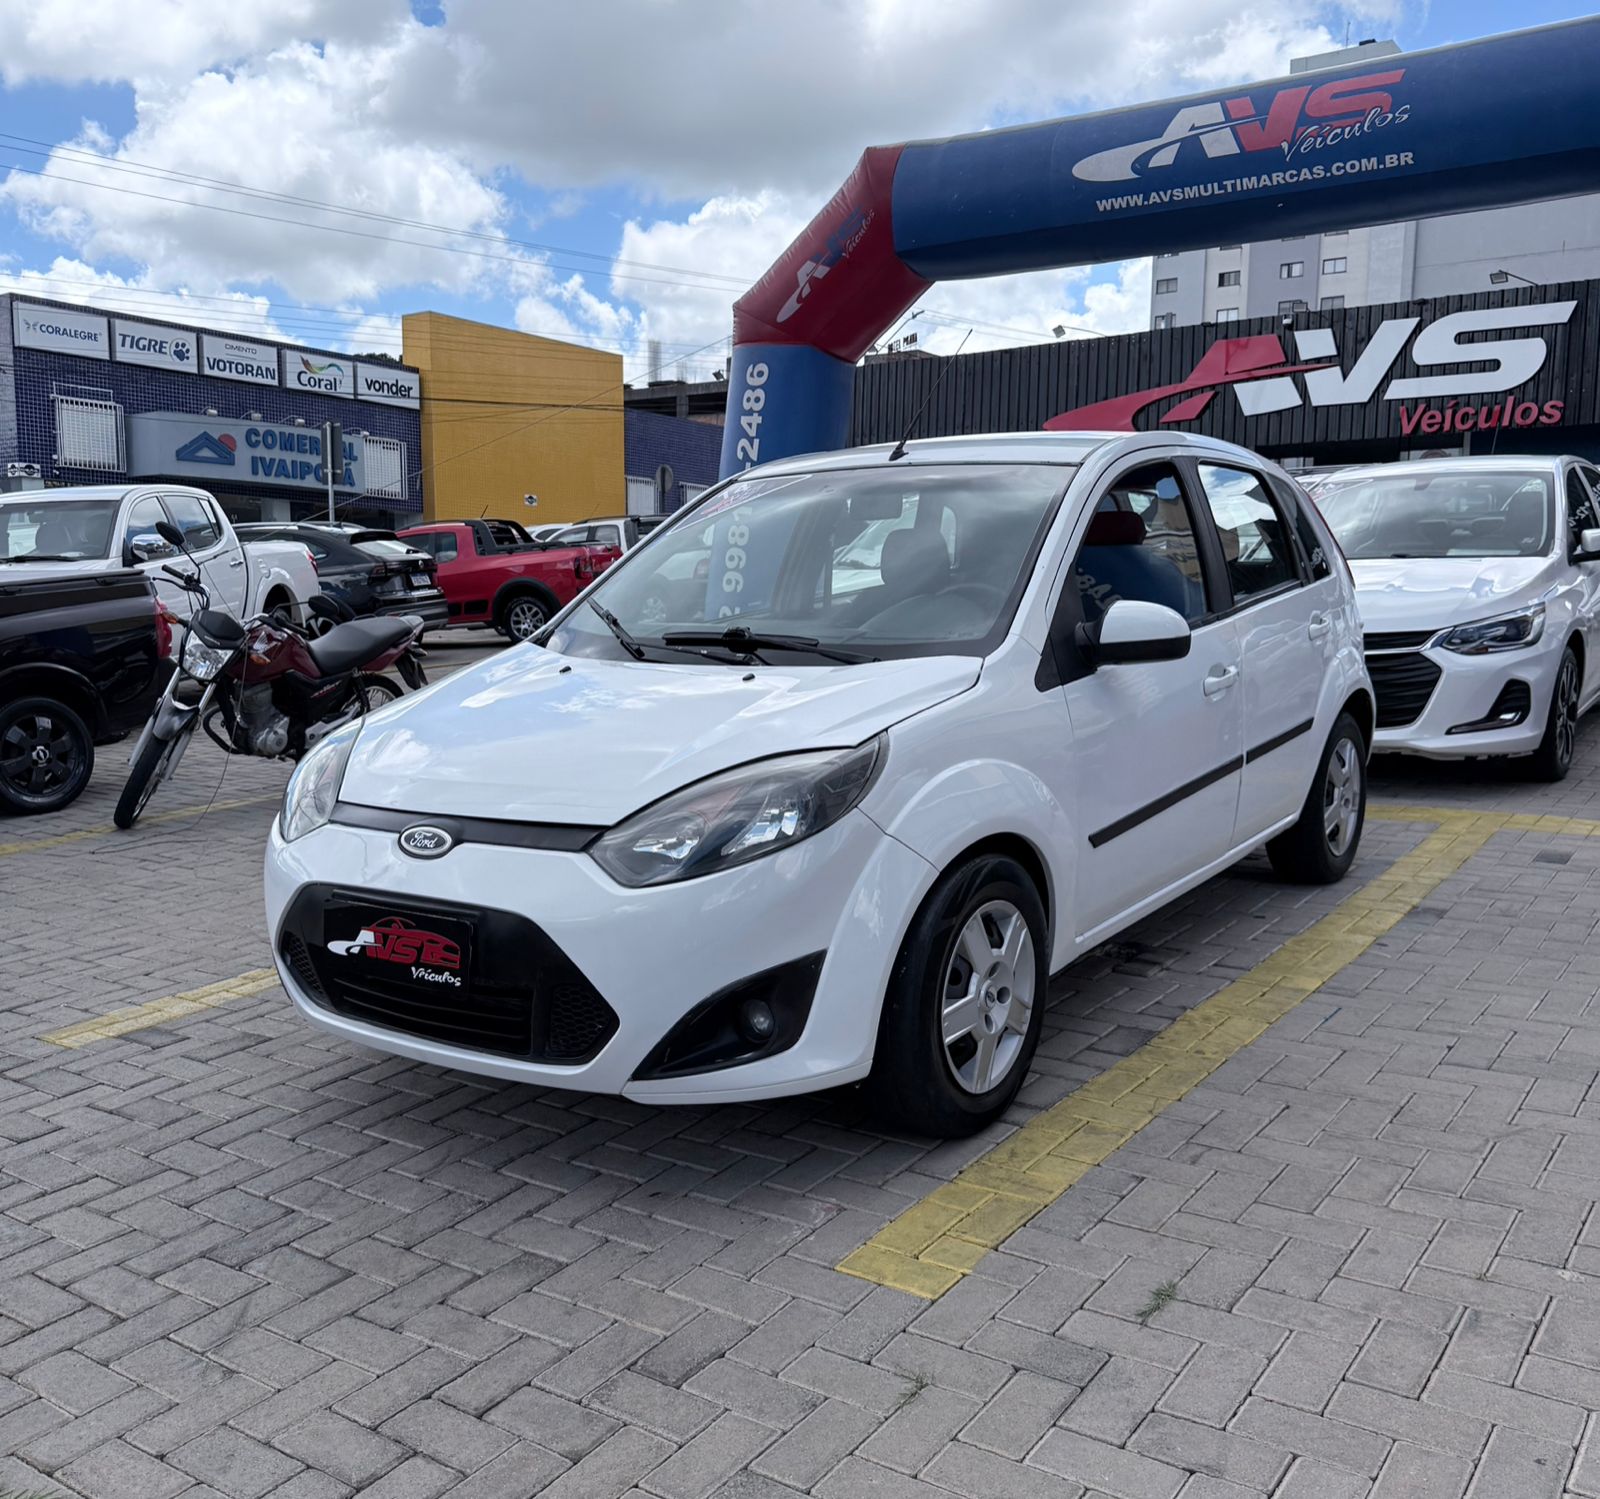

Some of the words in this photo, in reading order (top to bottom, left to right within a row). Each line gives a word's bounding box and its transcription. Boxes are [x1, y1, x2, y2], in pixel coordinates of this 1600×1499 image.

[1072, 68, 1406, 182] AVS
[1281, 102, 1411, 162] Veículos
[1096, 151, 1415, 212] WWW.AVSMULTIMARCAS.COM.BR
[39, 323, 99, 342] CORALEGRE
[118, 333, 169, 355] TIGRE
[206, 356, 276, 381] VOTORAN
[1042, 300, 1578, 431] AVS
[297, 370, 338, 391] Coral
[364, 377, 413, 399] vonder
[1399, 395, 1565, 435] Veículos
[410, 831, 438, 849] Ford
[327, 929, 421, 965] AVS
[411, 966, 462, 987] Veículos
